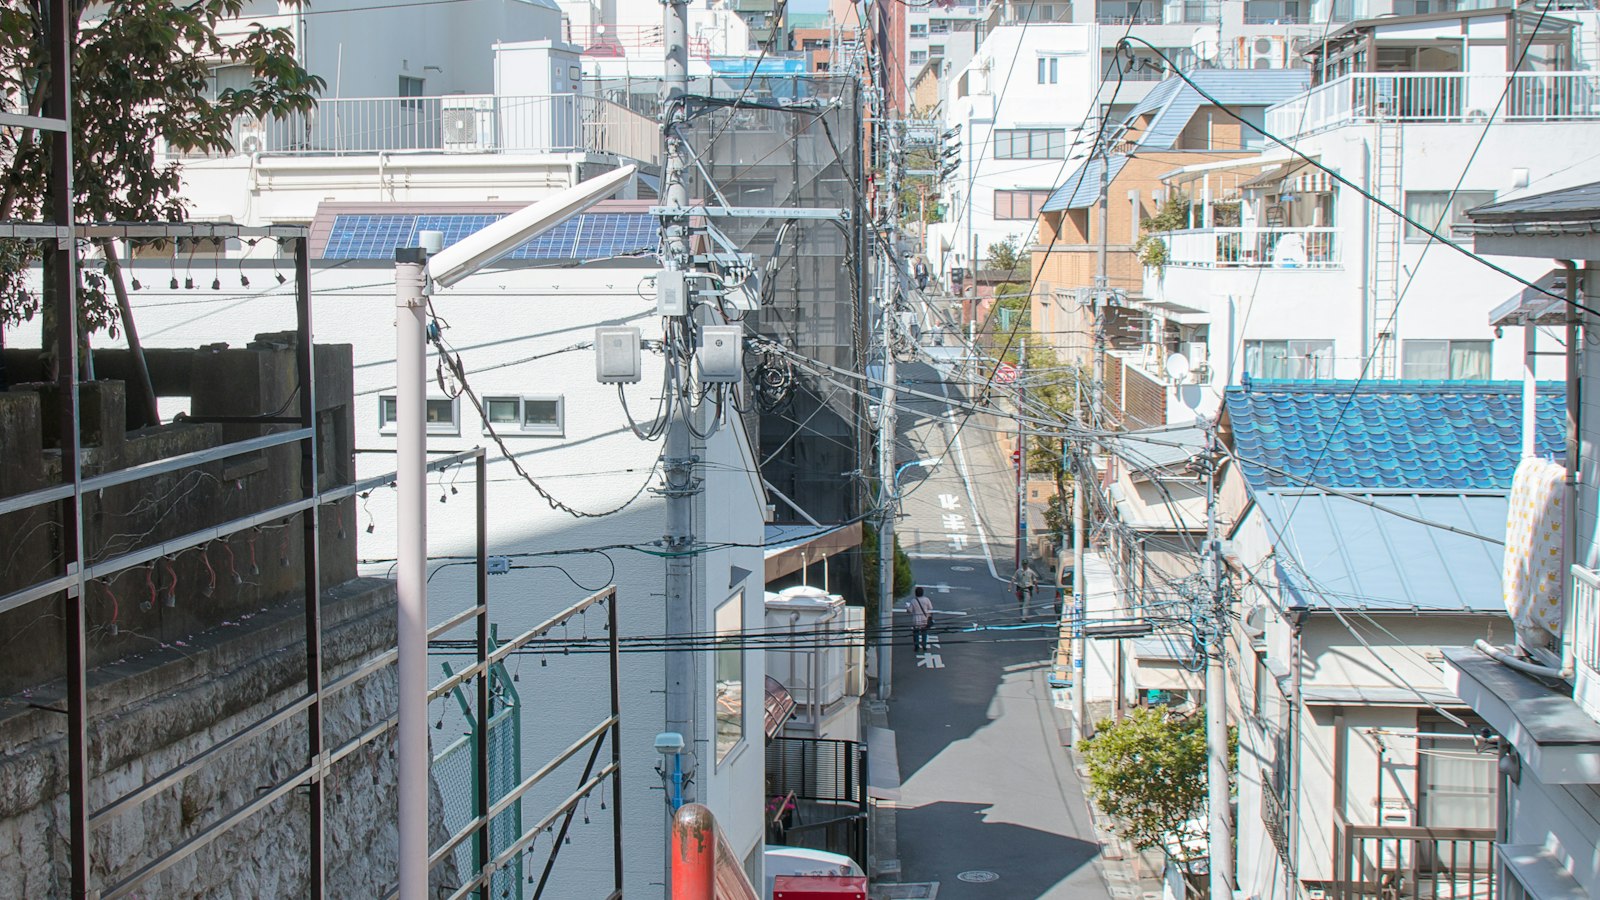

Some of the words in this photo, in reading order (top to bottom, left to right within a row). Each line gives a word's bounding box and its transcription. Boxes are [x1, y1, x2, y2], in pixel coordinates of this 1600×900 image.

[938, 494, 968, 550] 止まれ
[911, 620, 945, 668] まれ
